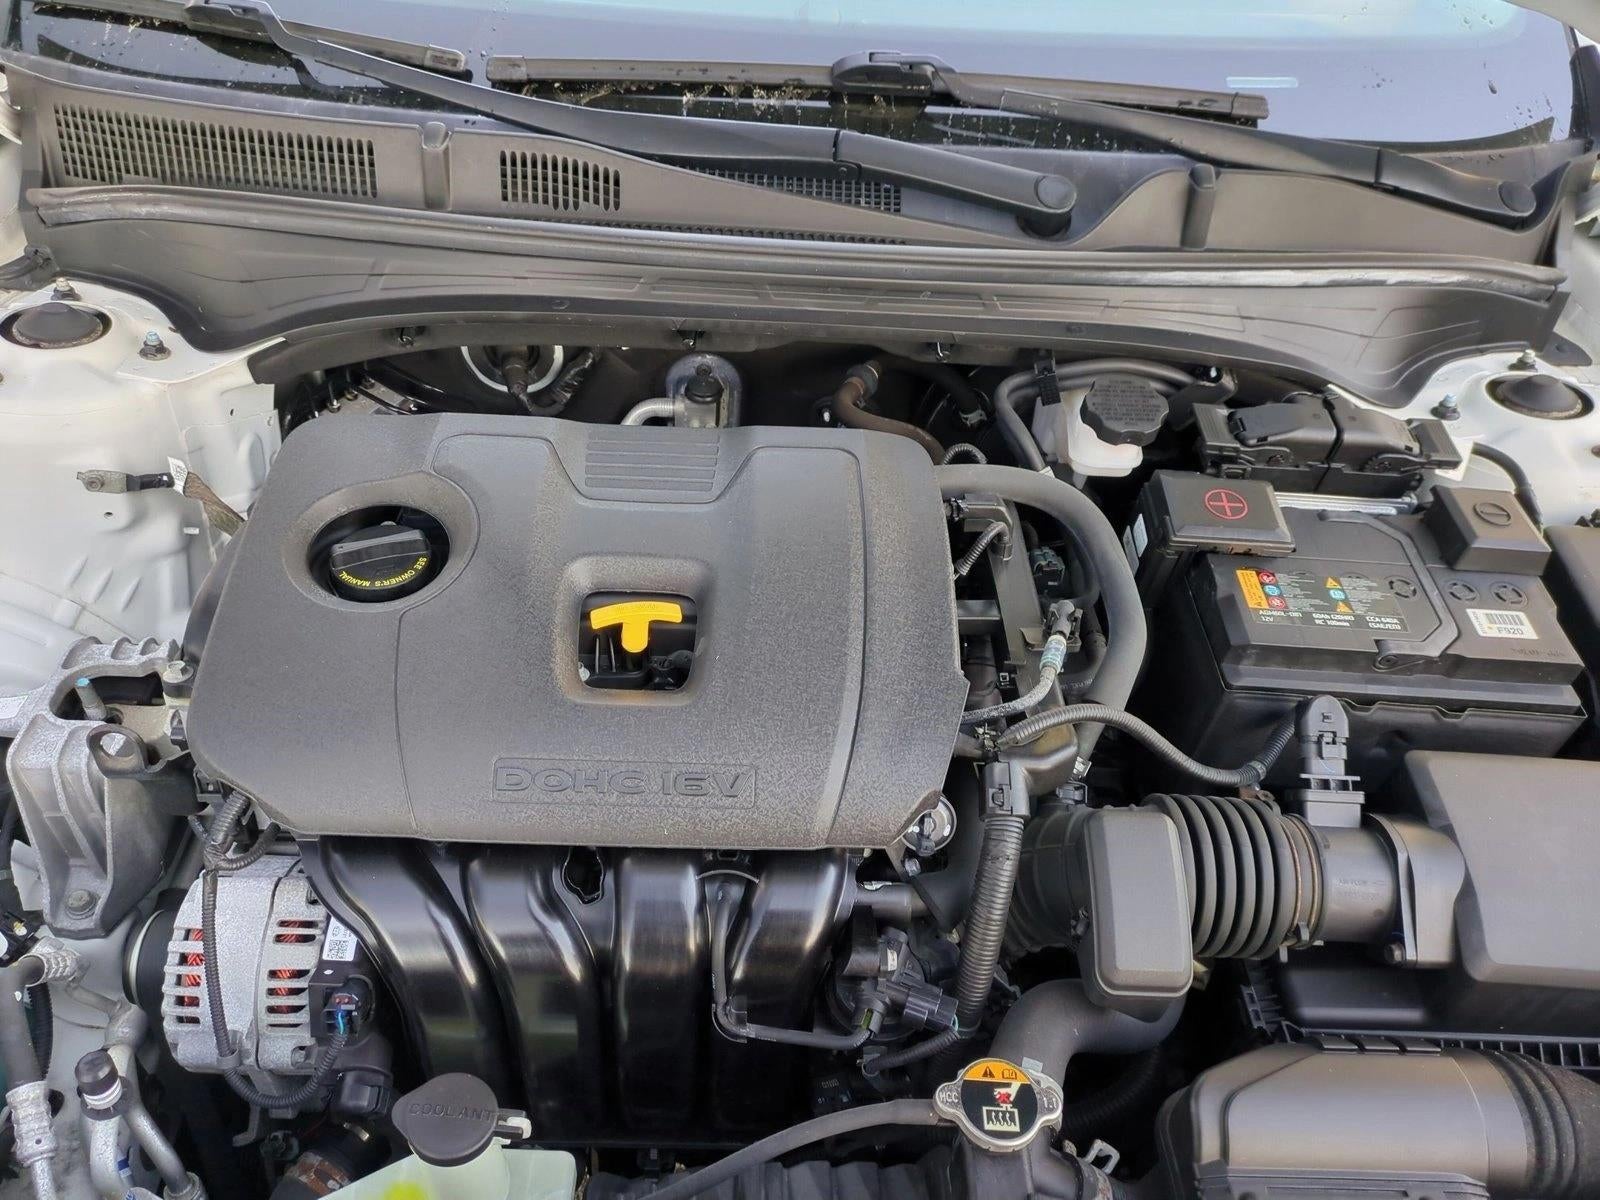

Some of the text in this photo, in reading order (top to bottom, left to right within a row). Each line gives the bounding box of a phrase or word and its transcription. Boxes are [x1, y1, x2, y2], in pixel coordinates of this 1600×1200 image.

[339, 557, 427, 587] SEE OWNER'S MANUAL
[1496, 625, 1524, 636] F920
[494, 766, 753, 797] DOHC 16V
[939, 1091, 959, 1104] HCC
[408, 1103, 498, 1122] COOLANT
